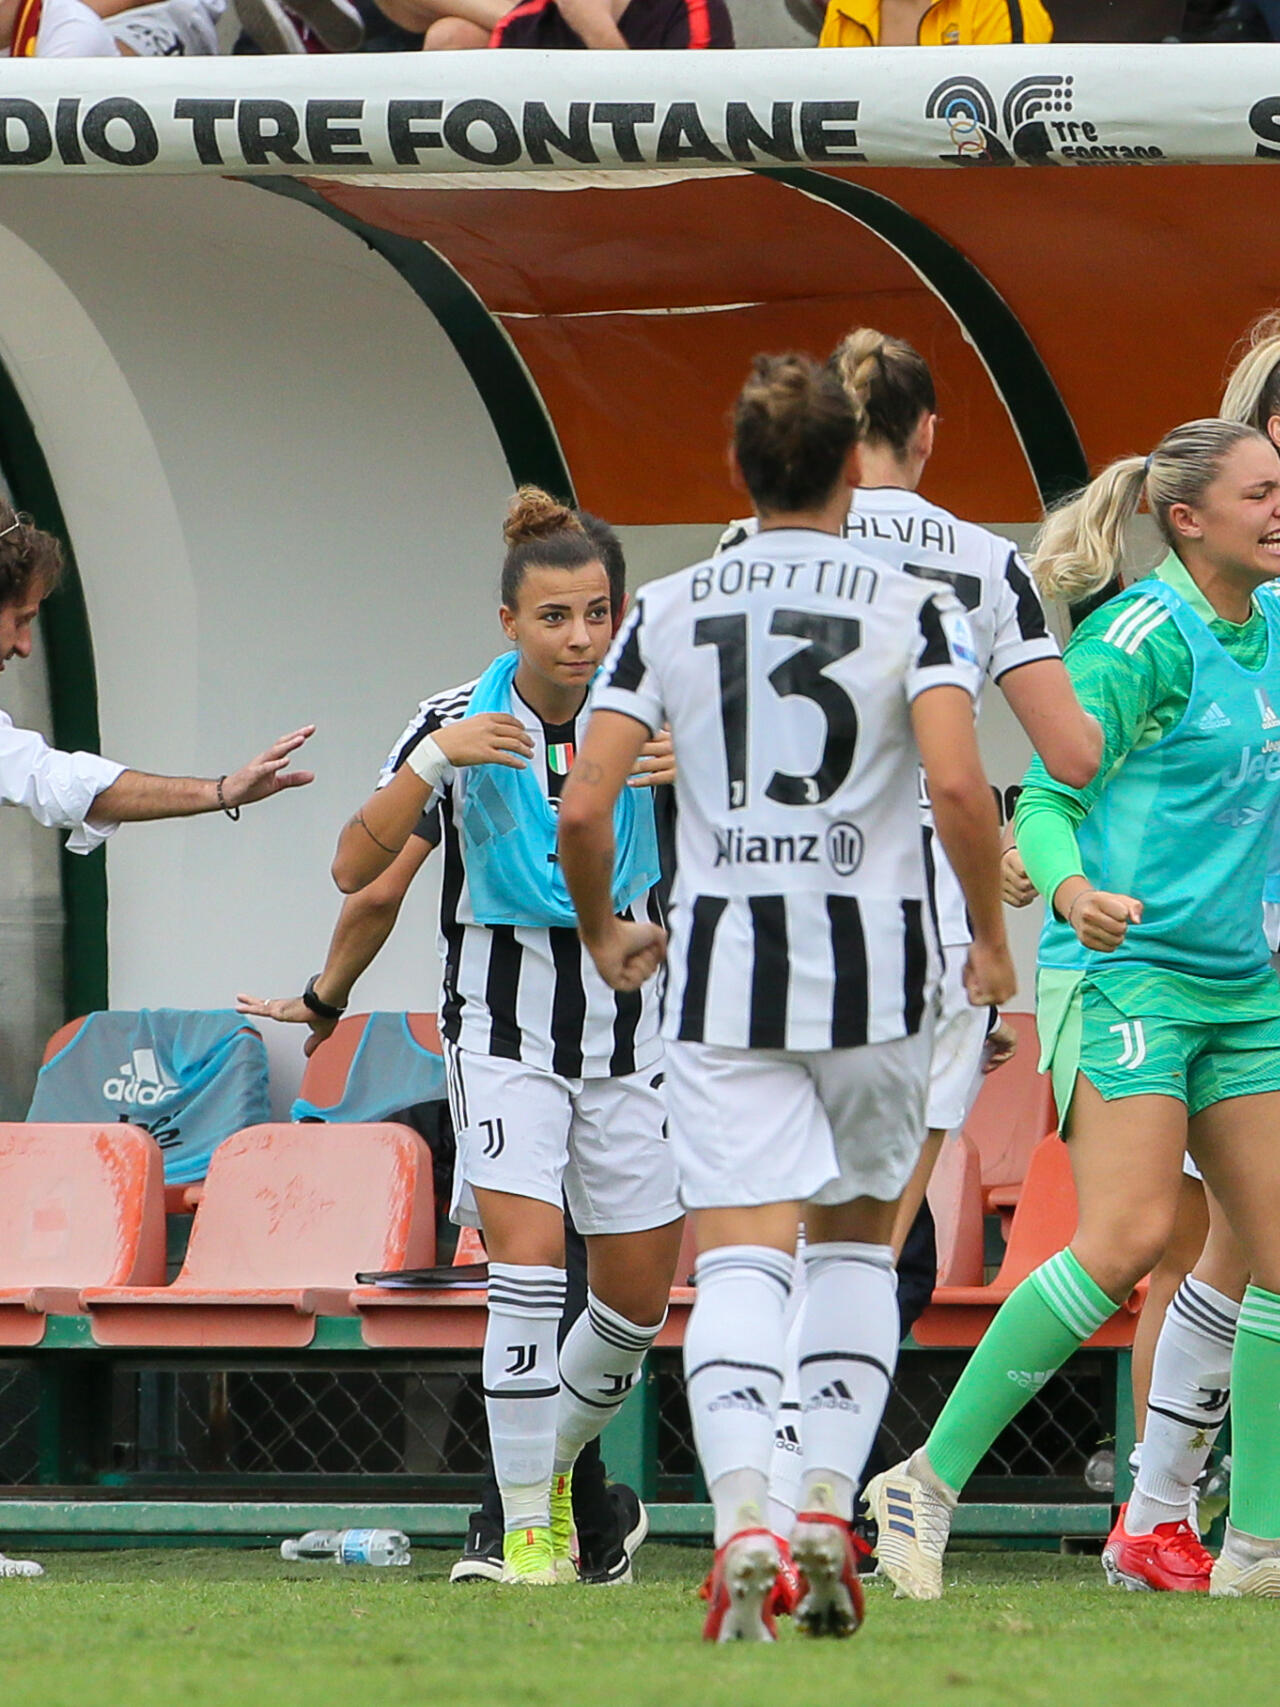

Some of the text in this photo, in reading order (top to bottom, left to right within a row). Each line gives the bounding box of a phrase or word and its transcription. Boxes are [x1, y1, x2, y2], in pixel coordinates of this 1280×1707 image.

[174, 99, 373, 165] TRE
[387, 99, 868, 165] FONTANE
[842, 511, 956, 555] ALVAI
[691, 560, 879, 605] BOATTIN
[692, 608, 861, 811] 13
